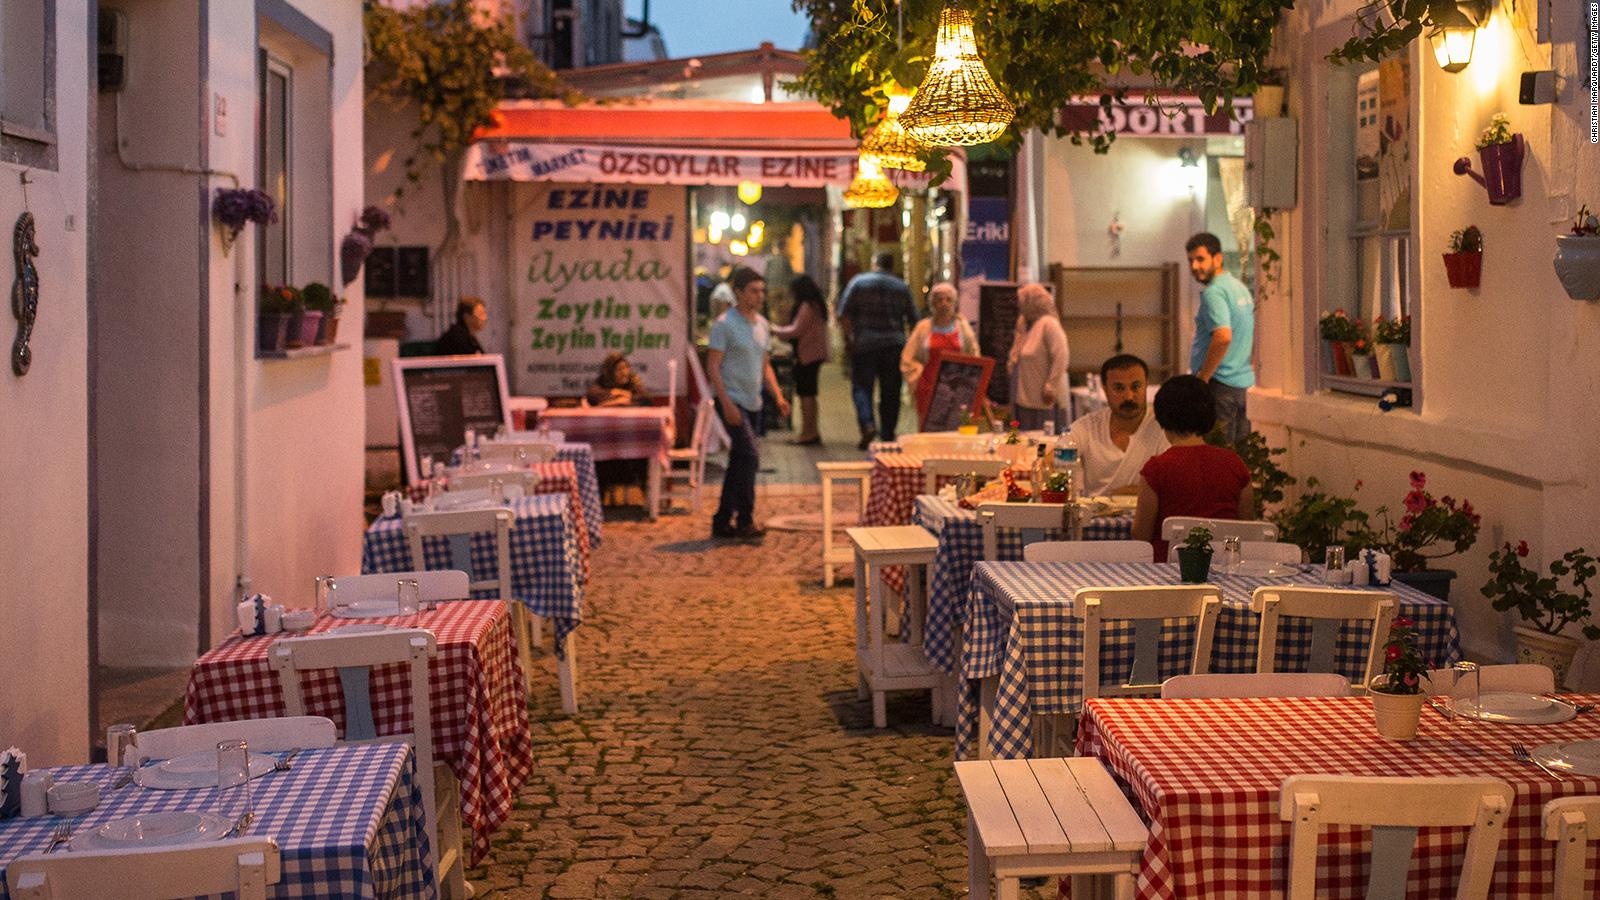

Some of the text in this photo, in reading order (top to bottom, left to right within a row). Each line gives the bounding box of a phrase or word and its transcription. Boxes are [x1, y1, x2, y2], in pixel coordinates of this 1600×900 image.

[599, 150, 739, 176] ÖZSOYLAR
[760, 155, 837, 179] EZİNE
[547, 184, 649, 209] EZİNE
[531, 213, 675, 241] PEYNİRİ
[527, 248, 672, 292] ilyada
[537, 296, 671, 324] Zeytin ve
[531, 325, 671, 355] Zeytin Yağları
